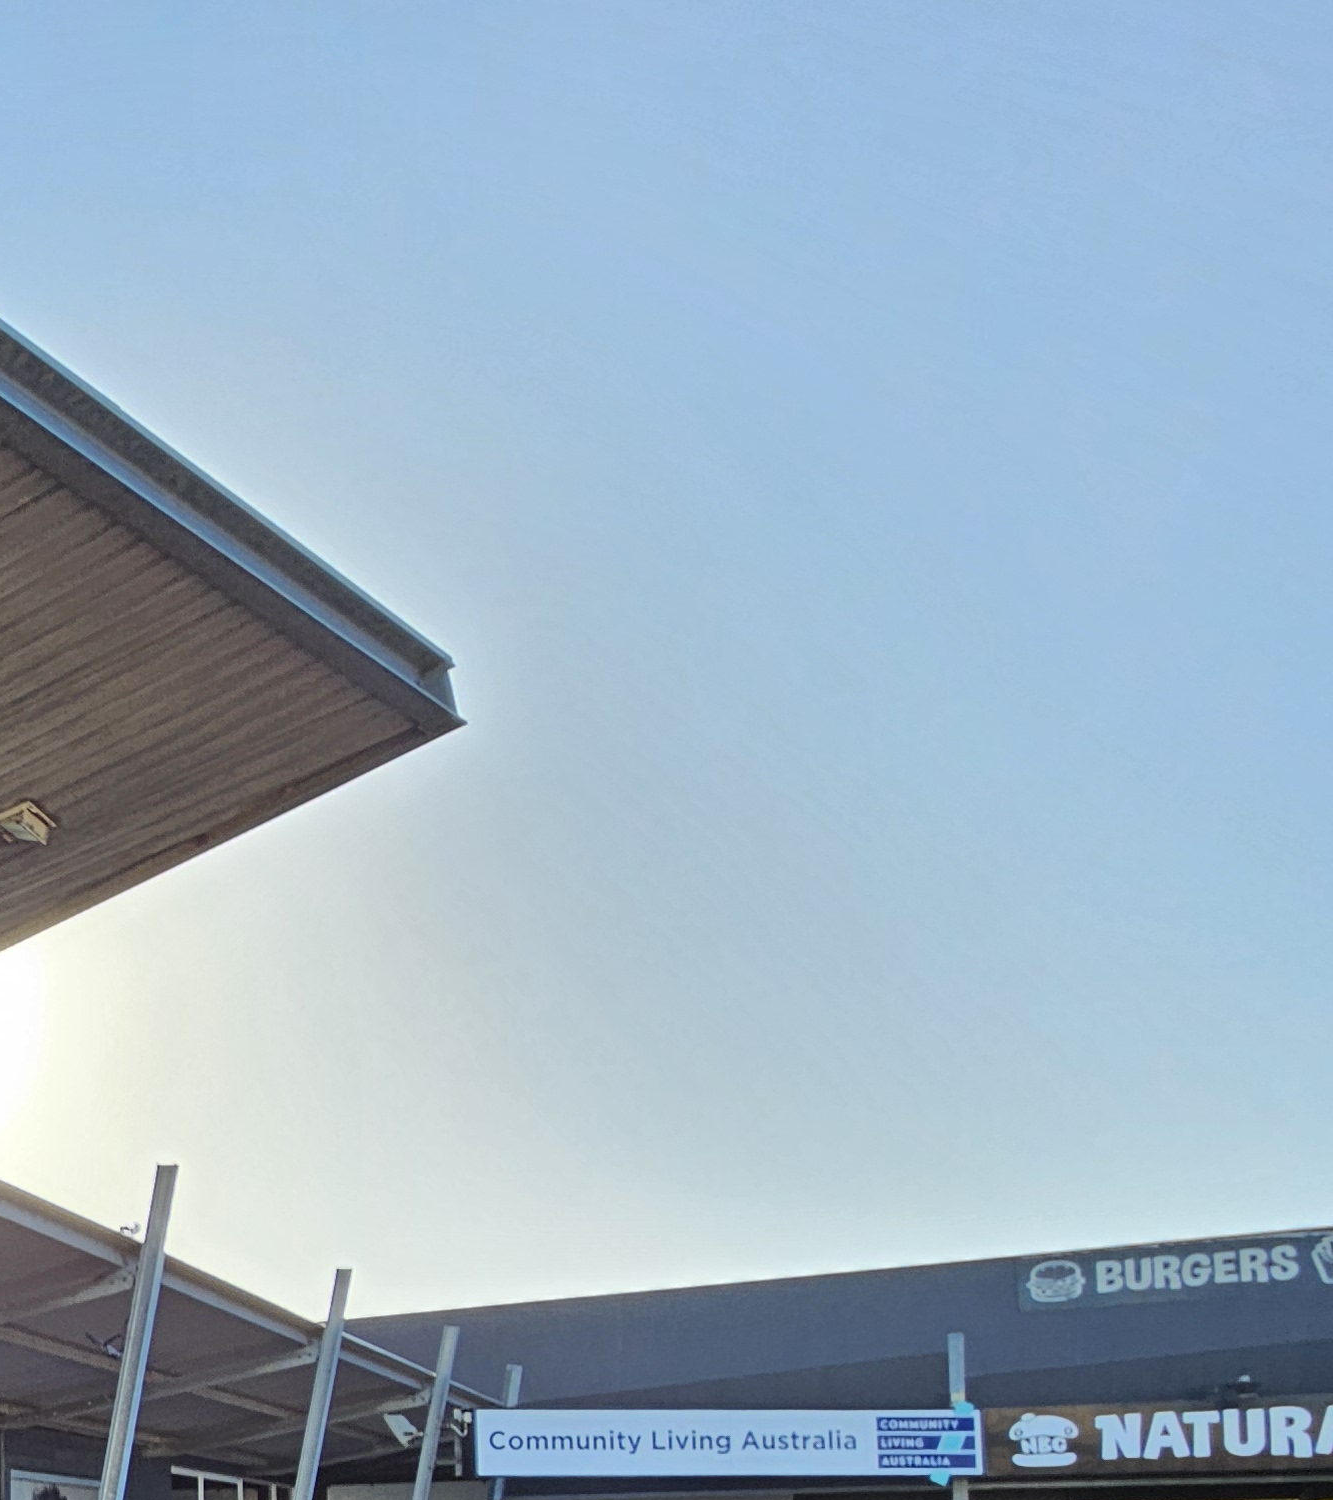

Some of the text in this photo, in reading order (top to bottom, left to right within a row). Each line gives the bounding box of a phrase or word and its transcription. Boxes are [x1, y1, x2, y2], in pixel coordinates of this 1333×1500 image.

[1095, 1244, 1300, 1294] BURGERS
[879, 1418, 959, 1430] COMMUNITY
[489, 1429, 858, 1455] Community Living Australia
[880, 1437, 925, 1449] LIVING
[881, 1455, 952, 1468] AUSTRALIA
